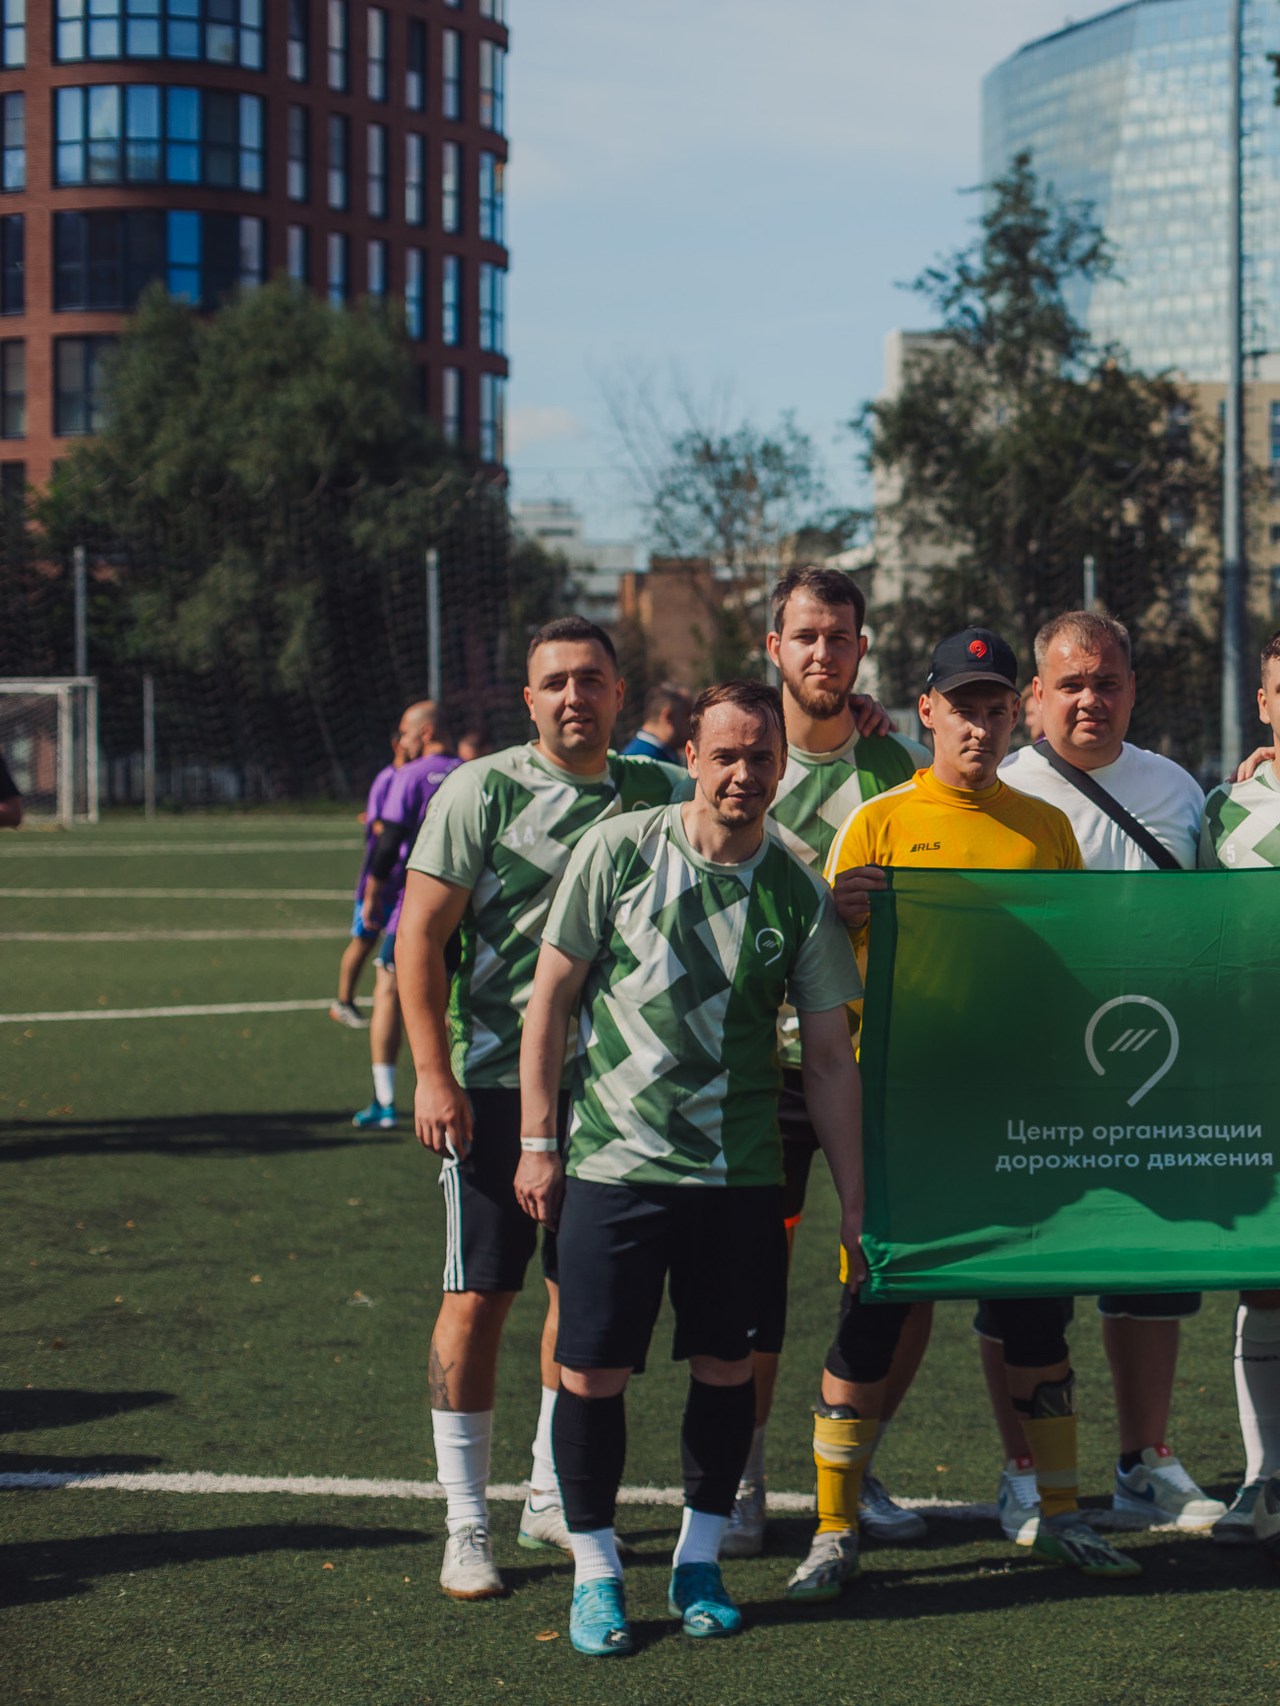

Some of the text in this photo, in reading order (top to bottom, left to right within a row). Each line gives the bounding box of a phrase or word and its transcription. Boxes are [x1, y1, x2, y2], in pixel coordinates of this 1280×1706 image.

[1226, 844, 1236, 864] 5
[1006, 1119, 1263, 1147] Центр организации
[994, 1152, 1274, 1175] дорожного движения
